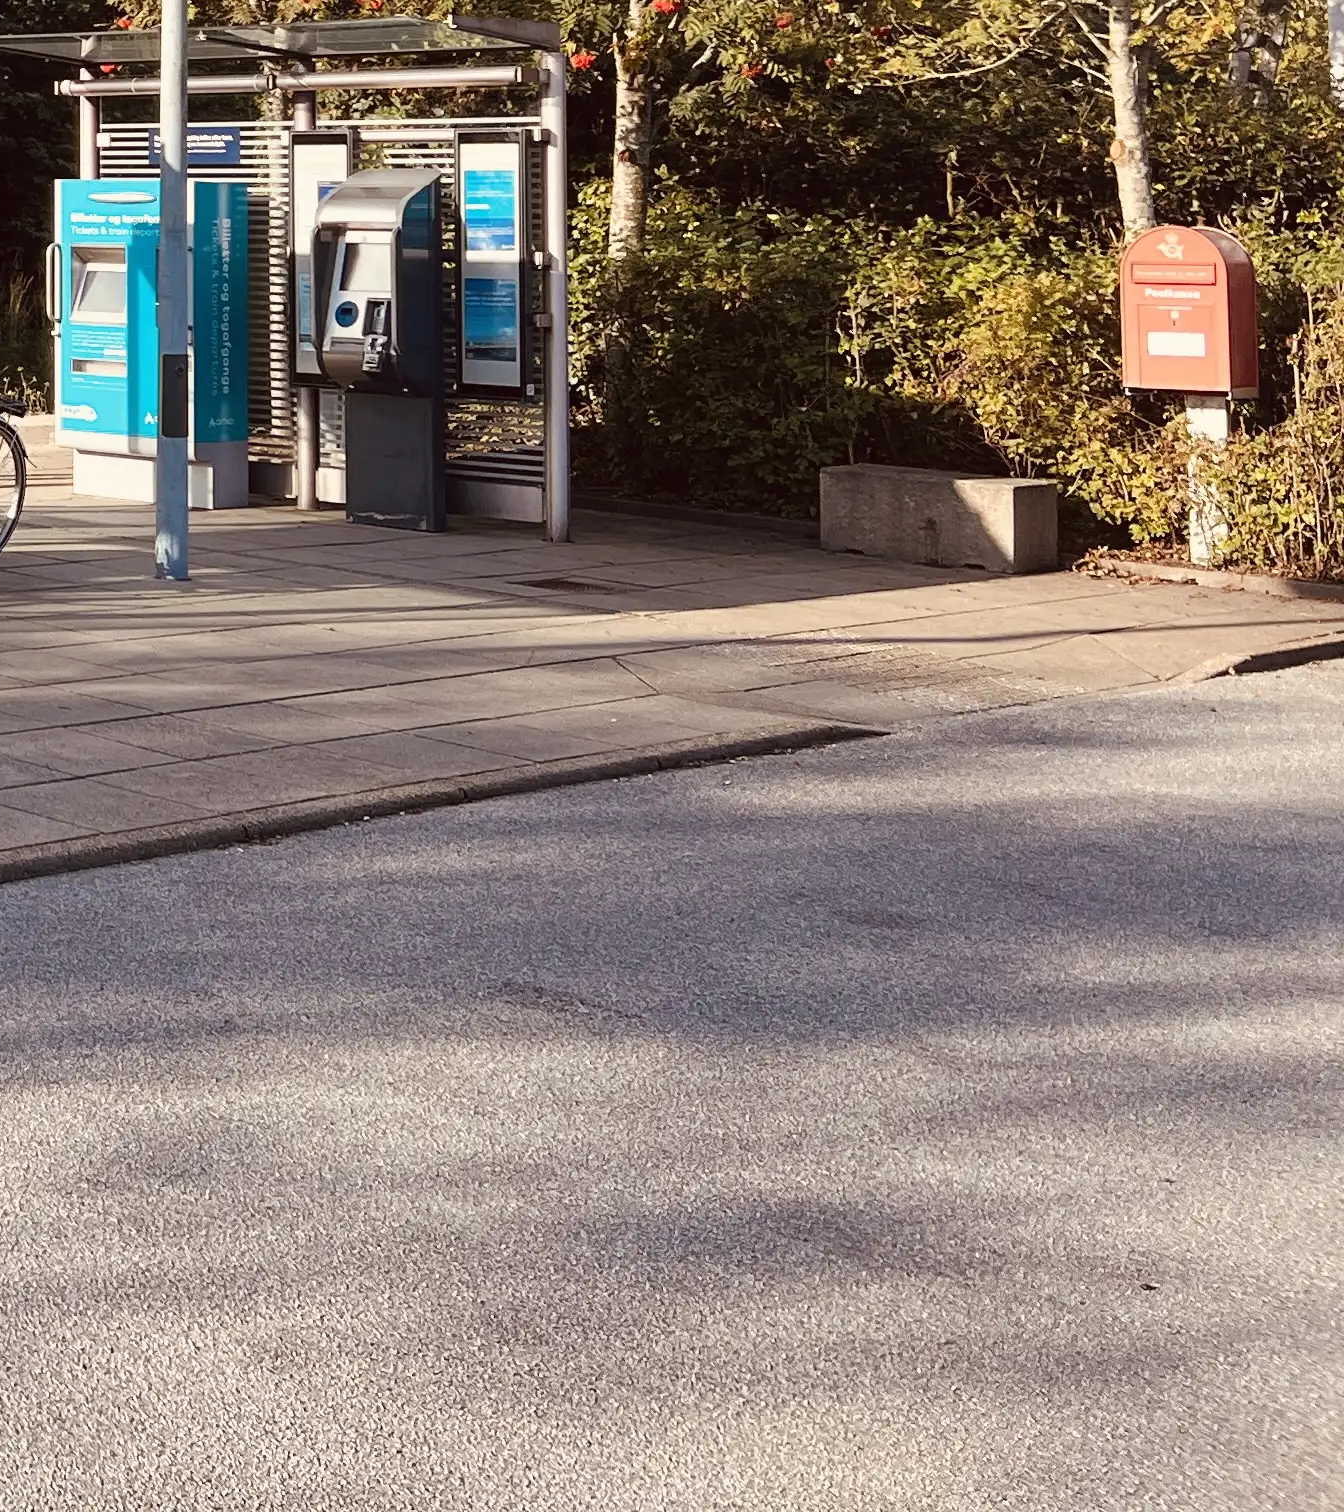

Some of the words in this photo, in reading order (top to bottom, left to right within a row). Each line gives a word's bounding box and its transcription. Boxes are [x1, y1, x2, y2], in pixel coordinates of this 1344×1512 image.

[210, 218, 221, 265] Tickets
[221, 218, 233, 279] Billetter
[211, 269, 220, 279] &
[220, 282, 231, 302] og
[211, 283, 220, 316] train
[220, 306, 233, 395] togafgange
